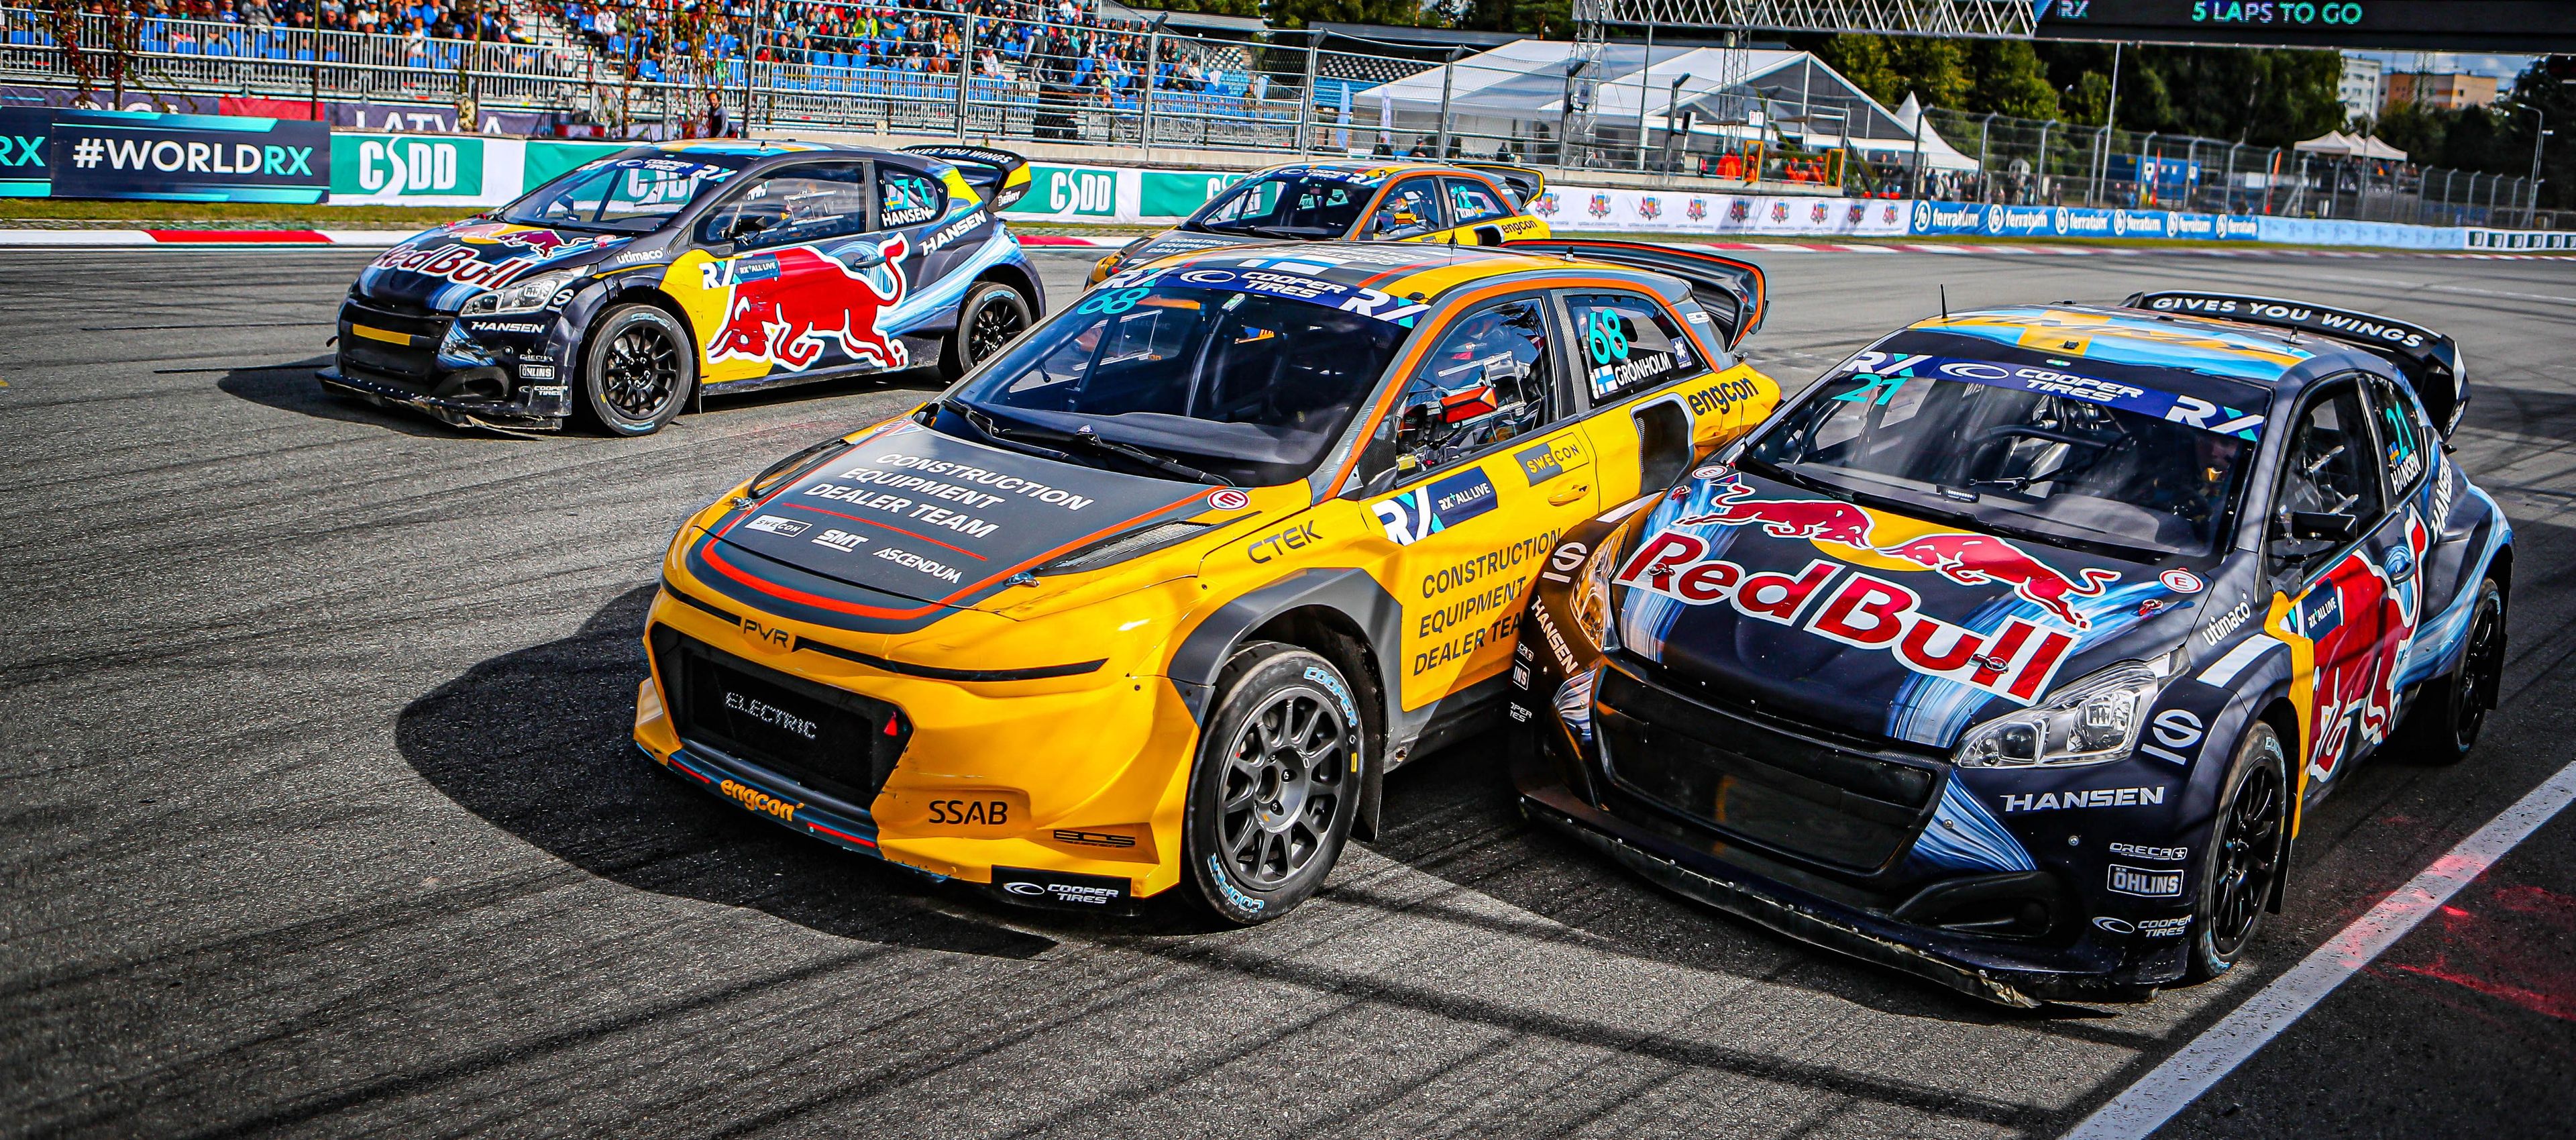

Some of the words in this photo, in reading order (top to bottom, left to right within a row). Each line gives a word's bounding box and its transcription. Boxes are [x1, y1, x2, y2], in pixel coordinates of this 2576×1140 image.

[2192, 1, 2207, 21] 5
[2213, 2, 2273, 23] LAPS
[2279, 3, 2315, 24] TO
[2321, 3, 2362, 24] GO
[73, 138, 313, 177] #WORLDRX
[359, 137, 457, 193] CSDD
[905, 147, 941, 155] IVES
[940, 148, 969, 156] YOU
[969, 149, 1013, 164] WINGS
[894, 177, 930, 208] 71
[1050, 170, 1112, 213] CSDD
[881, 206, 933, 227] HANSEN
[918, 210, 987, 257] HANSEN
[1501, 219, 1538, 235] engcon
[615, 247, 664, 265] utimaco
[698, 259, 743, 290] RX
[1101, 267, 1179, 289] RX
[1240, 271, 1348, 295] COOPER
[1245, 279, 1321, 299] TIRES
[1076, 287, 1151, 315] 68
[1339, 287, 1433, 329] RX
[471, 321, 545, 333] HANSEN
[1589, 308, 1629, 366] 68
[2152, 297, 2237, 313] GIVES
[2249, 302, 2312, 321] YOU
[2321, 313, 2424, 349] WINGS
[1613, 351, 1672, 387] GRÖNHOLM
[1843, 352, 1933, 376] RX
[1688, 375, 1760, 417] engcon
[1832, 374, 1914, 405] 21
[2015, 368, 2144, 399] COOPER
[2025, 379, 2122, 402] TIRES
[2165, 395, 2265, 442] RX
[2385, 401, 2416, 460] 21
[1525, 442, 1581, 474] SWECON
[2390, 450, 2422, 496] HANSEN
[839, 467, 1006, 509] EQUIPMENT
[875, 453, 1094, 511] CONSTRUCTION
[756, 519, 802, 533] SWECON
[804, 483, 912, 513] DEALER
[908, 503, 1000, 538] TEAM
[1371, 485, 1446, 546] RX
[817, 528, 869, 548] SMT
[1247, 519, 1324, 564] CTEK
[872, 547, 963, 584] ASCENDUM
[1422, 527, 1562, 599] CONSTRUCTION
[1418, 576, 1527, 639] EQUIPMENT
[1614, 528, 1845, 626] Red
[1805, 571, 2080, 706] Bull
[2202, 597, 2252, 647] utimaco
[743, 619, 789, 648] PWR
[1413, 623, 1487, 676] DEALER
[1531, 595, 1578, 674] HANSEN
[1303, 665, 1358, 728] COOPER
[724, 691, 817, 740] ELECTRIC
[720, 778, 797, 822] engcon
[929, 799, 1008, 825] SSAB
[2000, 786, 2165, 813] HANSEN
[2110, 842, 2172, 856] ORECA
[1047, 884, 1119, 898] COOPER
[1207, 852, 1265, 913] COOPER
[2113, 867, 2179, 894] ÖHLINS
[1057, 893, 1108, 904] TIRES
[2137, 914, 2192, 929] COOPER
[2145, 926, 2186, 937] TIRES
